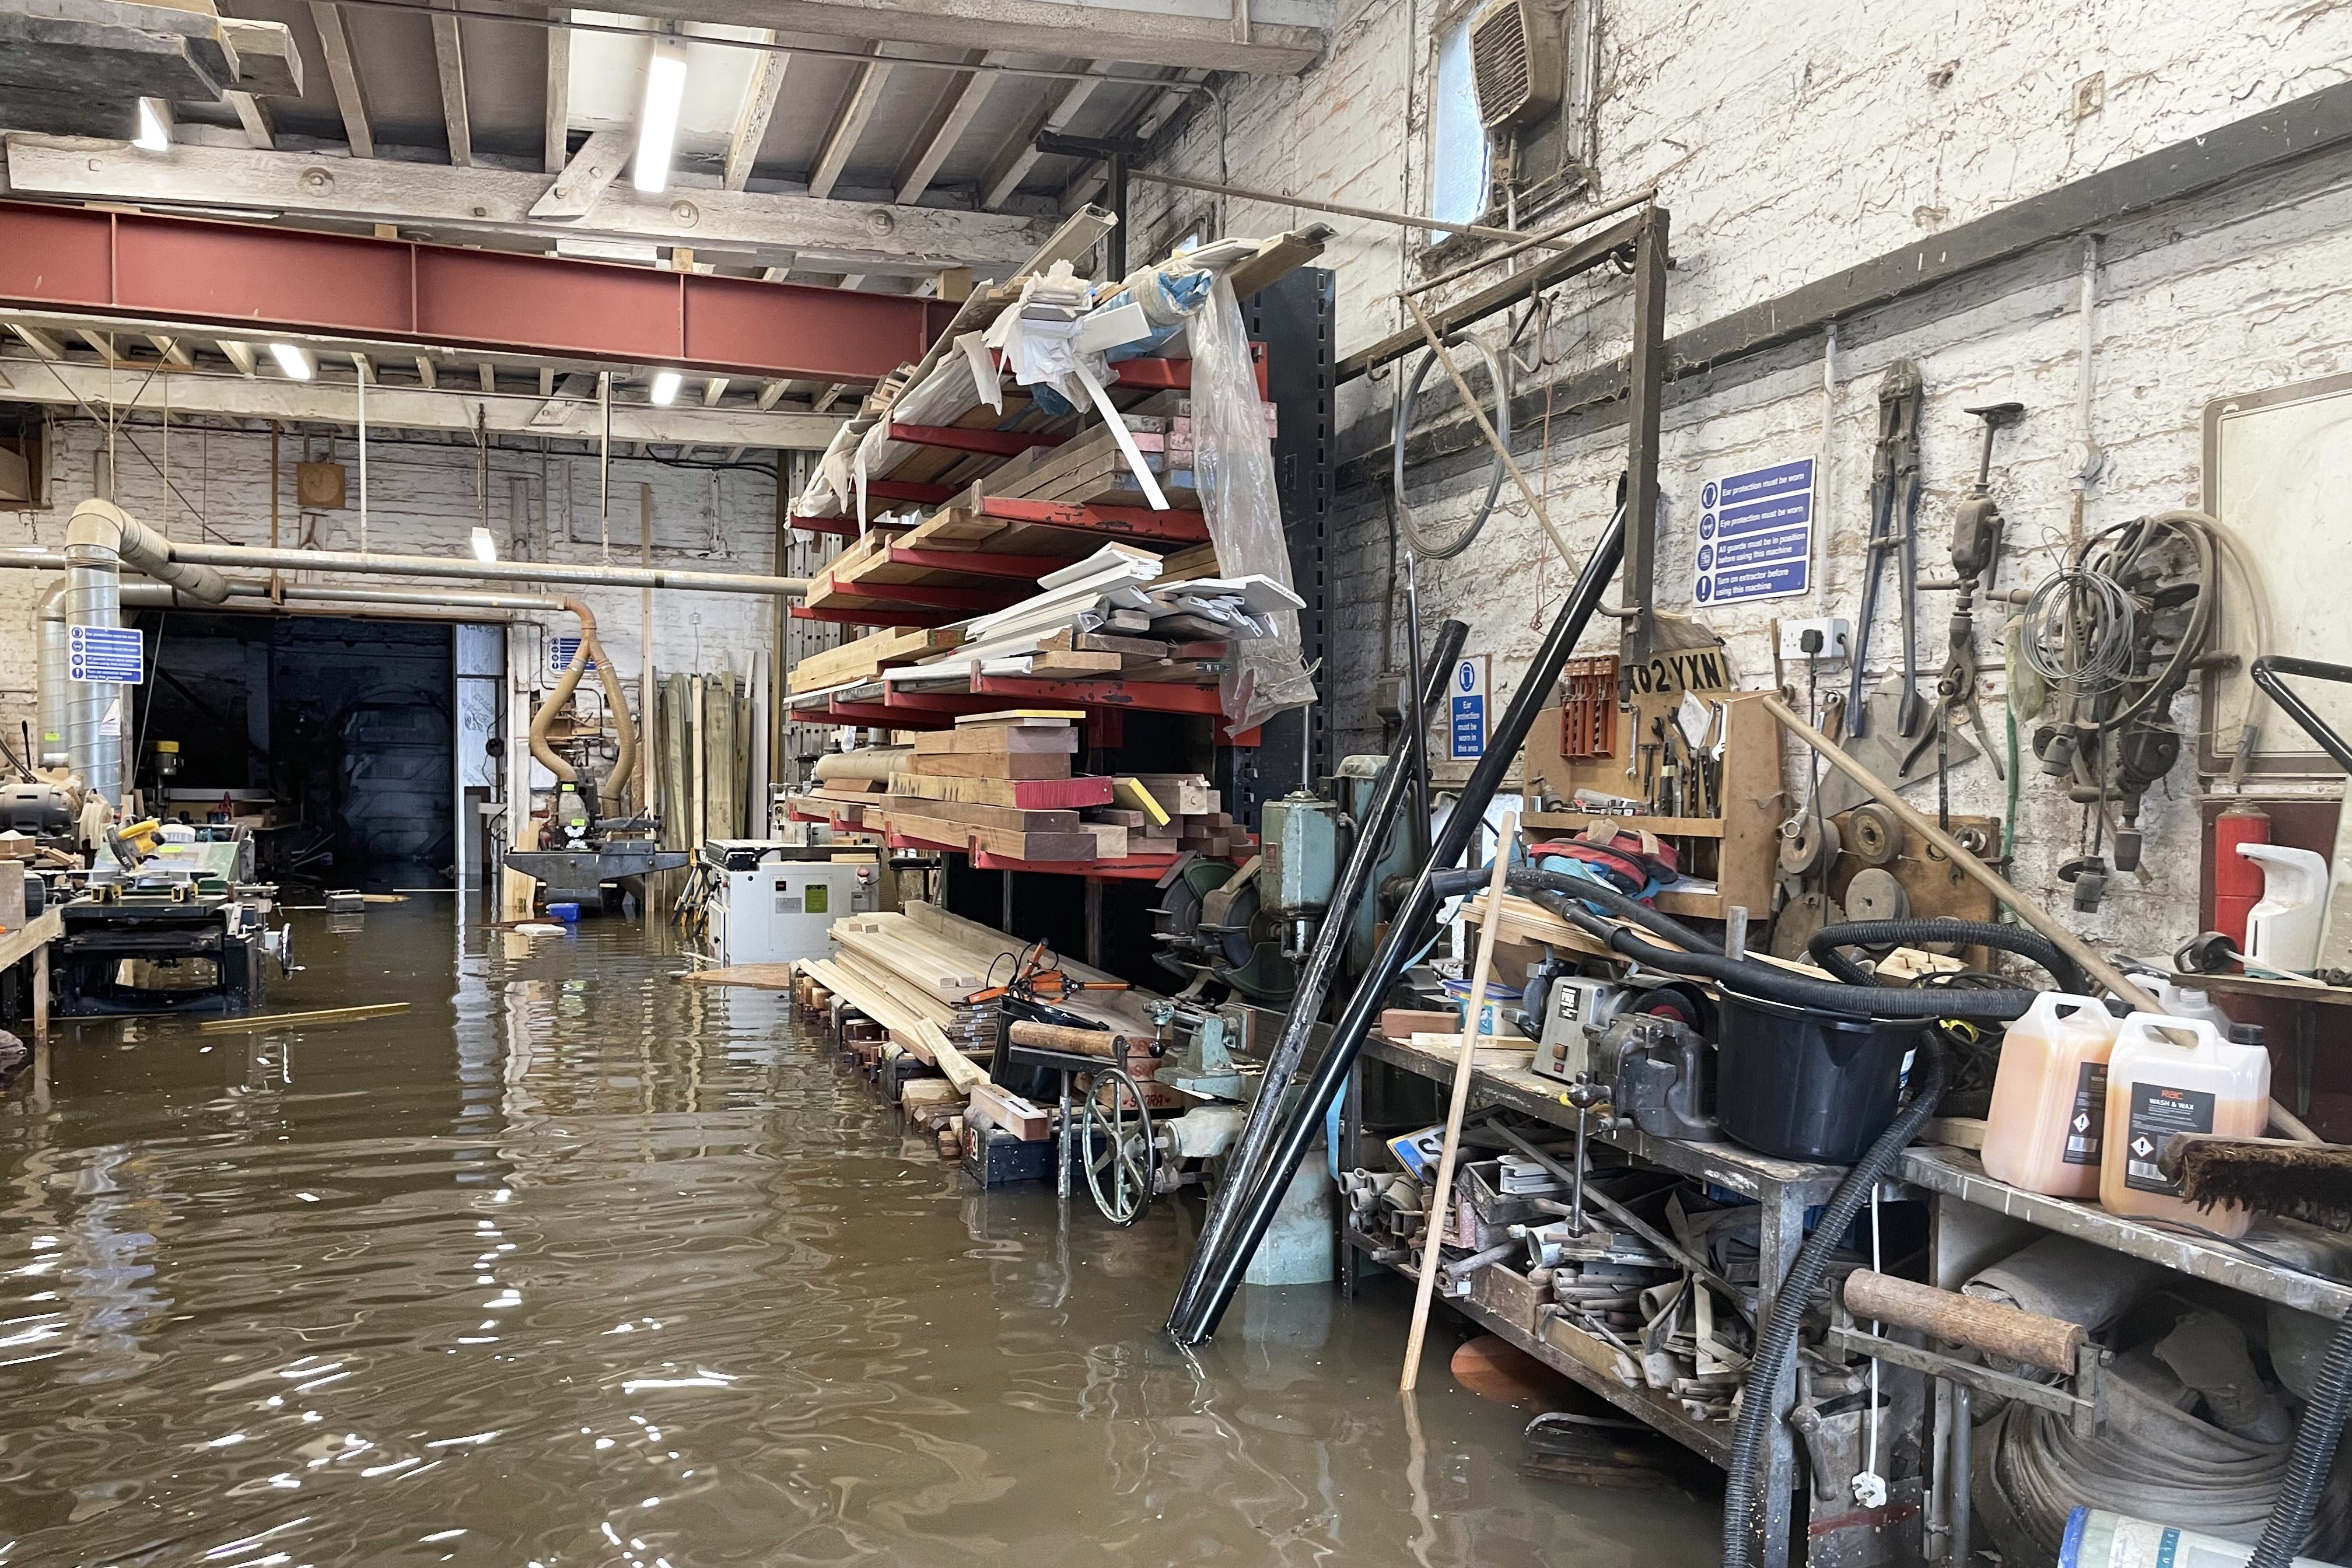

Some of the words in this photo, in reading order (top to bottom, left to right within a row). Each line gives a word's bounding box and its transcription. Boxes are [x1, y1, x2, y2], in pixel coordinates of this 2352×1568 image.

[1732, 482, 1762, 495] protection
[1762, 478, 1778, 488] must
[1779, 476, 1787, 484] be
[1788, 474, 1804, 482] worn
[1720, 520, 1731, 528] Eye
[1731, 514, 1760, 527] protection
[1761, 510, 1777, 519] must
[1747, 540, 1762, 548] must
[1779, 533, 1805, 544] position
[1718, 555, 1735, 564] before
[1736, 552, 1752, 561] using
[1754, 550, 1765, 558] this
[1766, 546, 1792, 556] machine
[1739, 572, 1767, 582] extractor
[1768, 569, 1789, 578] before
[1716, 588, 1731, 596] using
[1745, 582, 1772, 592] machine
[1669, 653, 1721, 690] YXN
[1456, 712, 1479, 722] protection
[2149, 1098, 2170, 1107] WASH
